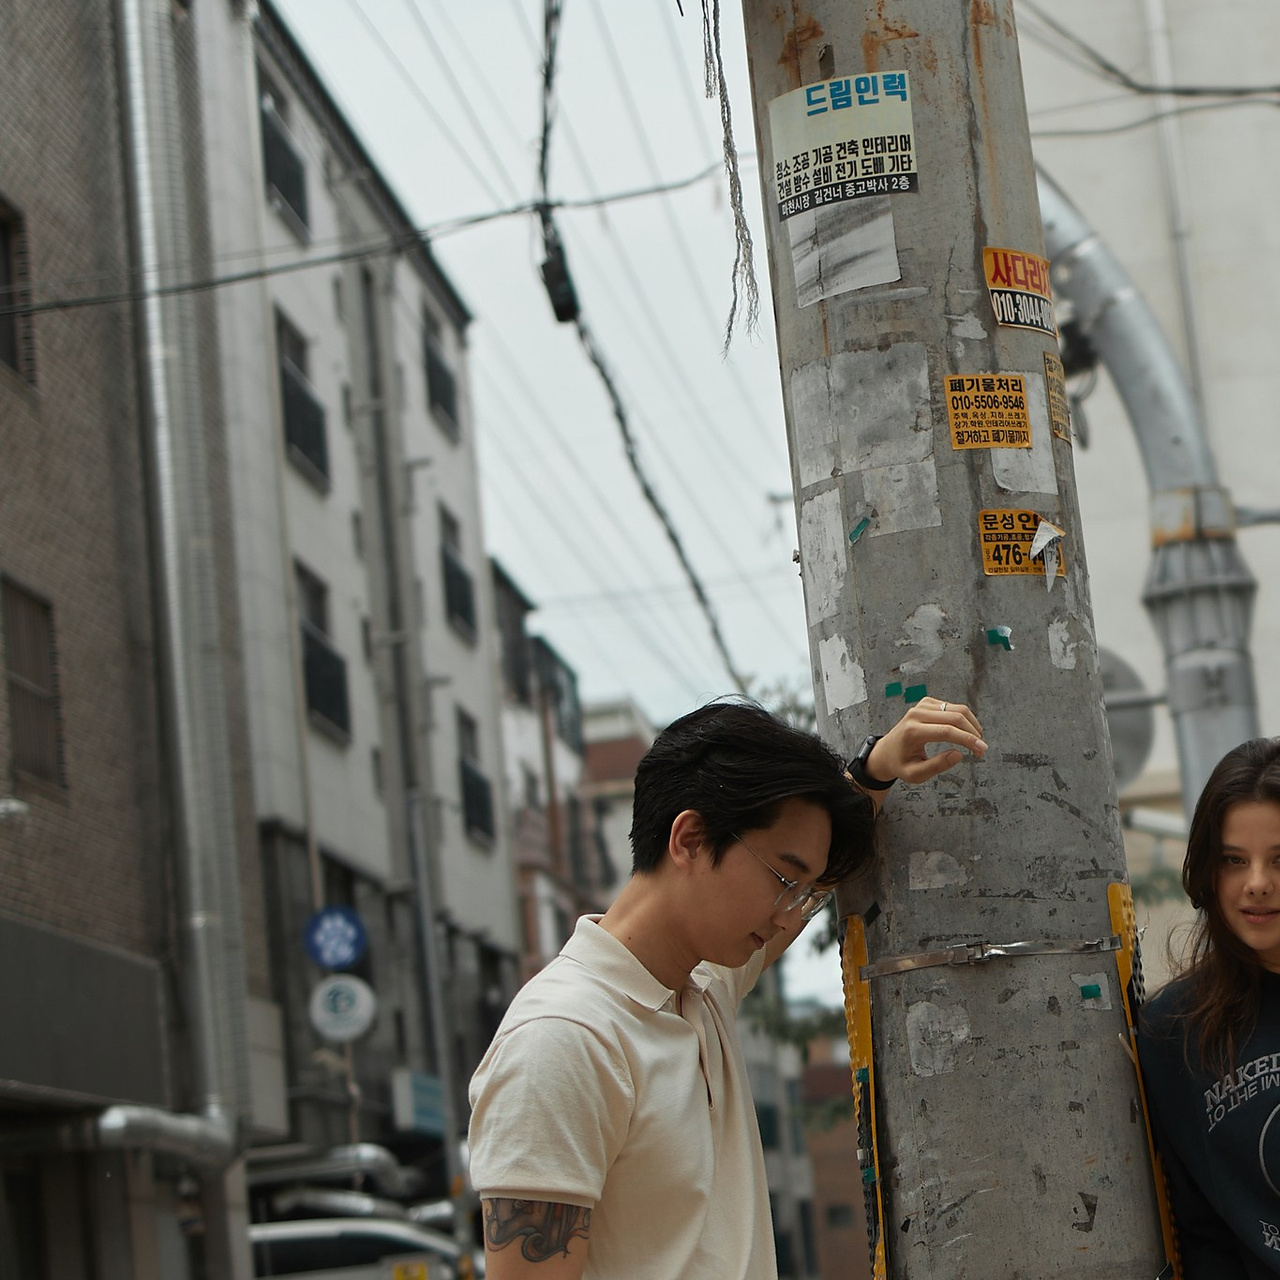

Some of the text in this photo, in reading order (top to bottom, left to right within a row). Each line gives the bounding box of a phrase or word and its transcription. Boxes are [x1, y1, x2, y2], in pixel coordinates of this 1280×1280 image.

[806, 73, 907, 117] 드림인력
[776, 134, 912, 180] 청소 조공 기공 건축 인테리어
[777, 154, 913, 200] 건설 방수 설비 전기 도배 기타
[781, 175, 910, 216] 마천시장 길건너 중고박사 2층
[949, 377, 1023, 393] 폐기물처리
[955, 429, 1030, 445] 철거하고 폐기물까지
[983, 513, 1039, 531] 문성인
[1258, 1219, 1280, 1236] TO
